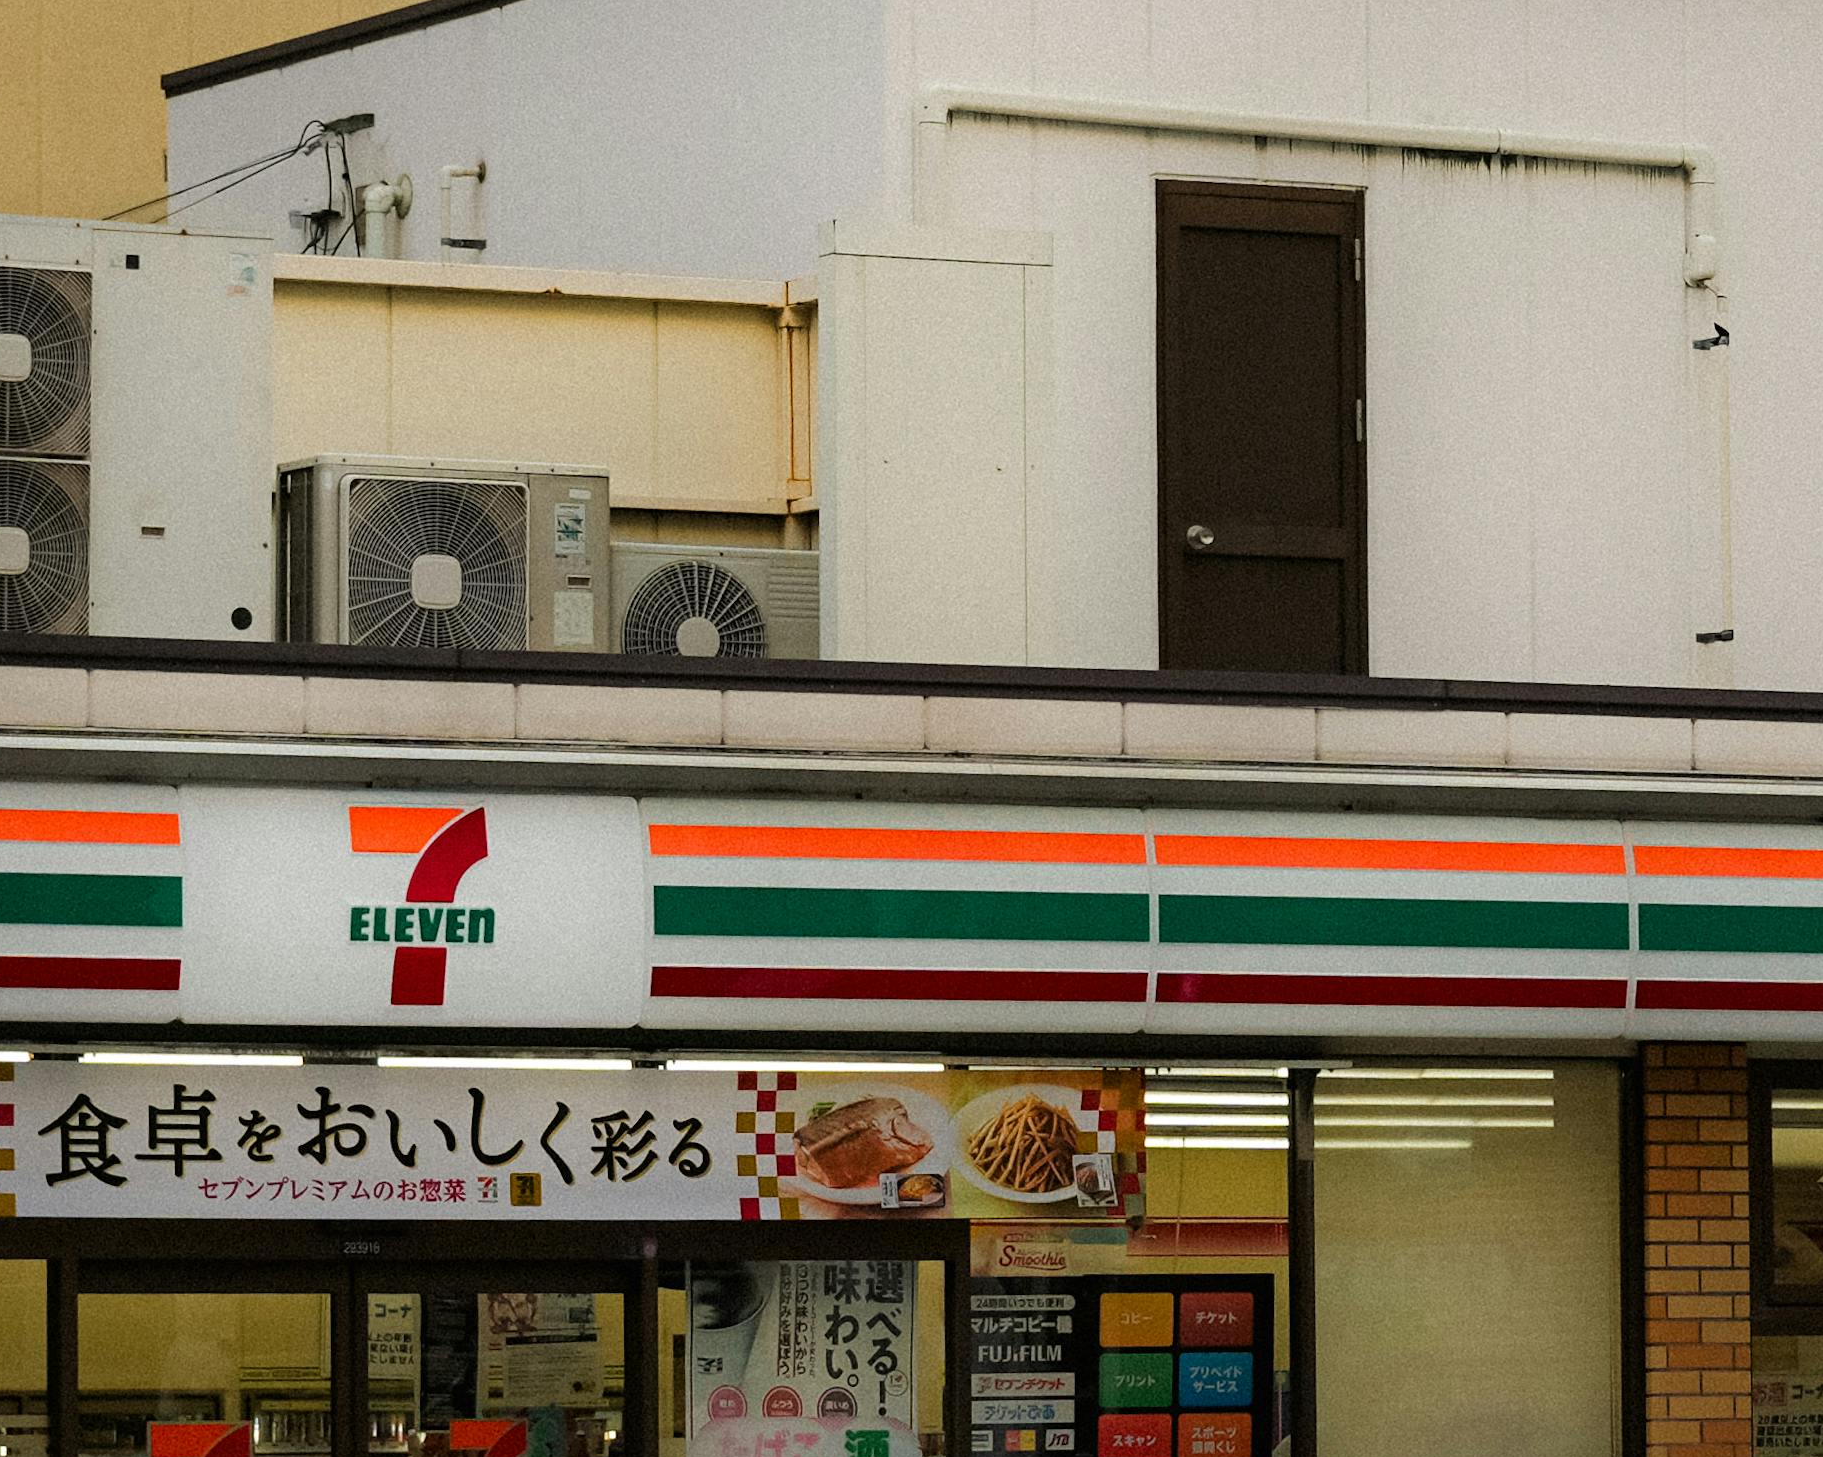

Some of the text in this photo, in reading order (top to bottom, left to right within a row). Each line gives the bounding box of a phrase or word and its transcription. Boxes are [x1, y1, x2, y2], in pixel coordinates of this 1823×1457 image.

[38, 1084, 714, 1187] 食卓をおいしく彩る
[198, 1177, 467, 1204] セブンプレミアムのお惣菜
[825, 1261, 861, 1387] 味わい。
[1120, 1313, 1153, 1326] コピー
[1195, 1311, 1238, 1325] チケット
[1188, 1365, 1243, 1380] プリペイド
[994, 1378, 1065, 1391] セブンチケット
[1115, 1374, 1156, 1388] プリント
[1192, 1380, 1239, 1393] サービス
[1191, 1426, 1238, 1439] スポーツ
[1112, 1434, 1157, 1448] スキャン
